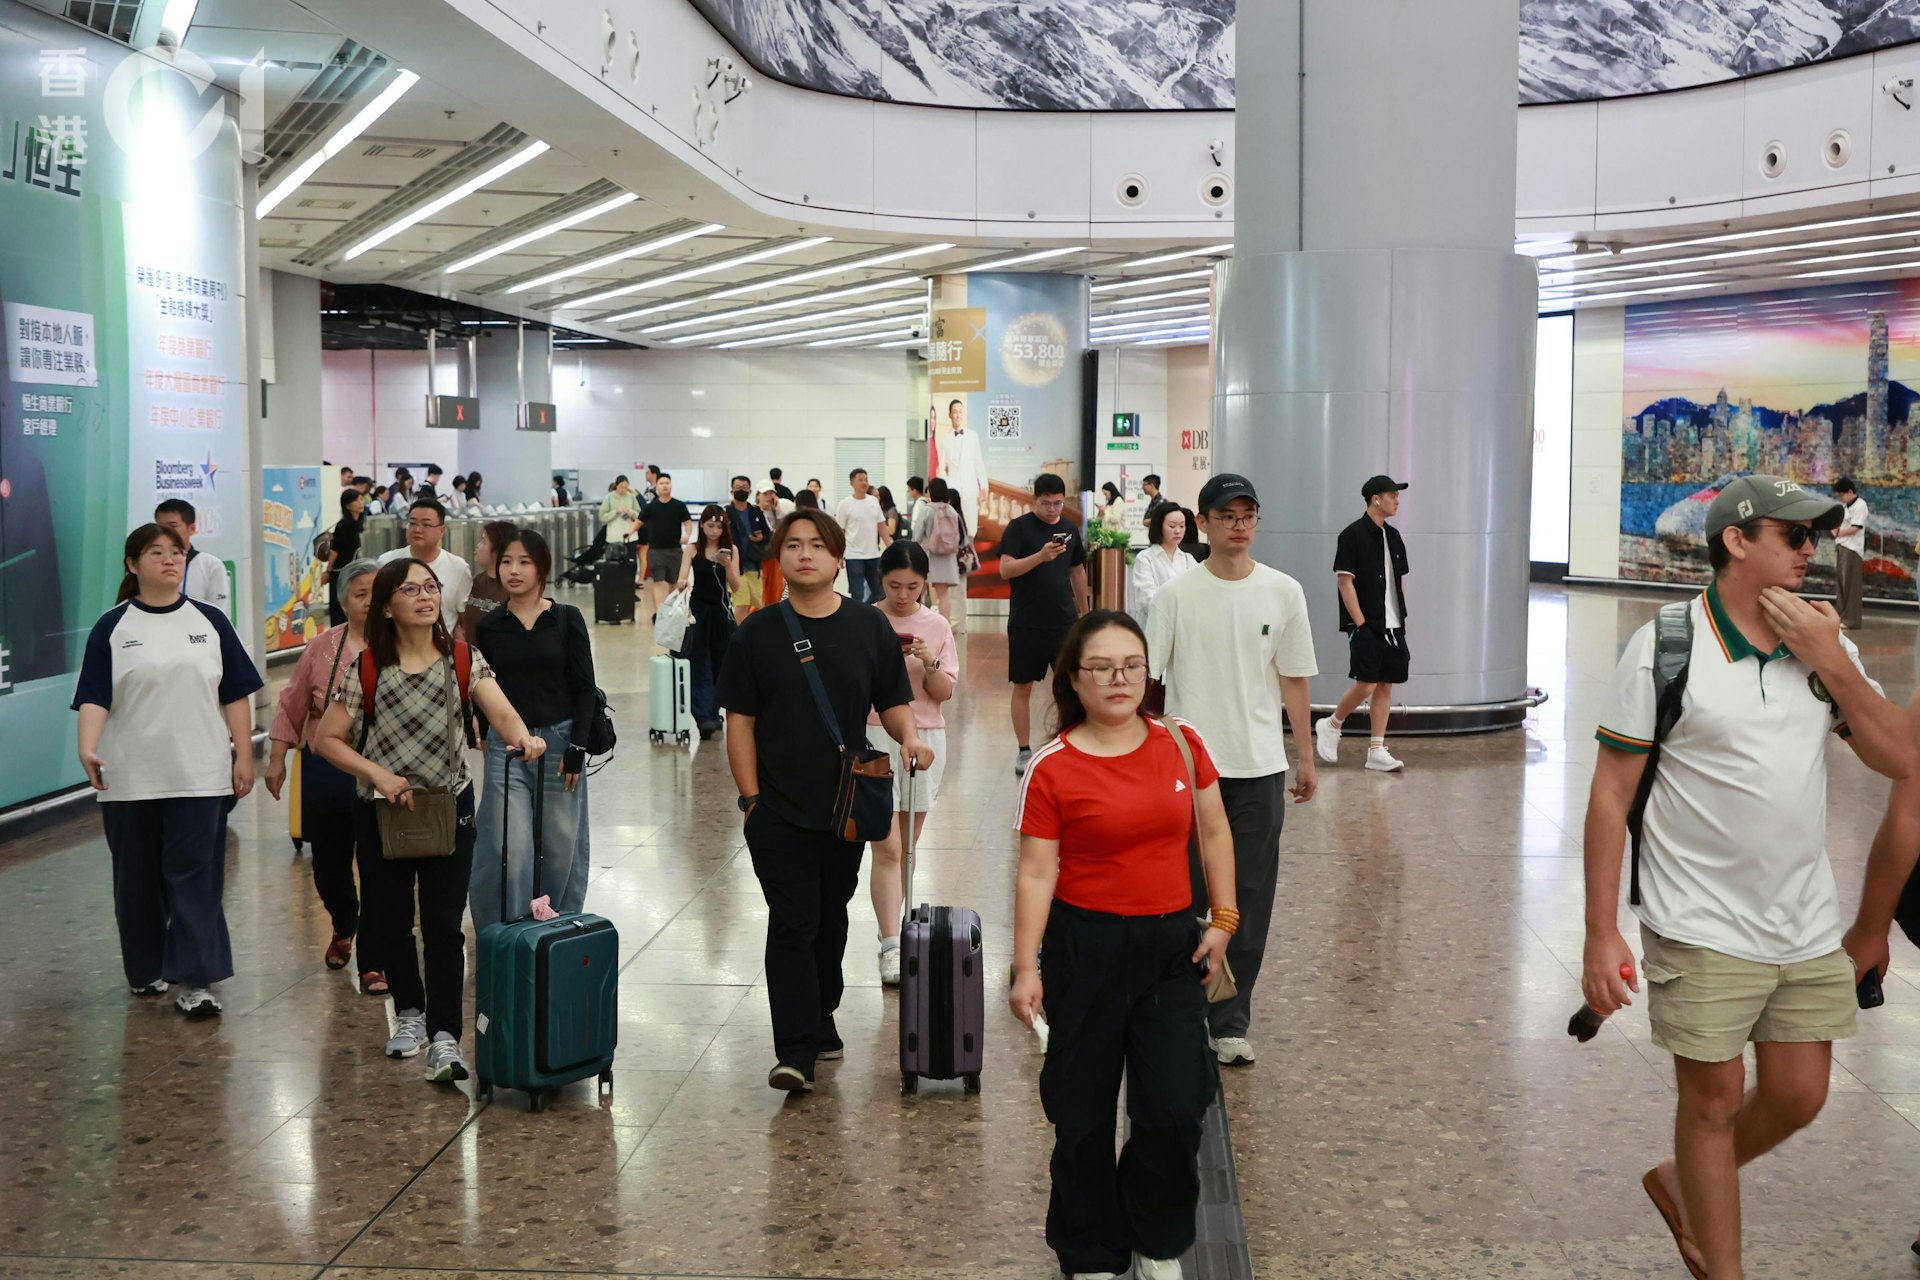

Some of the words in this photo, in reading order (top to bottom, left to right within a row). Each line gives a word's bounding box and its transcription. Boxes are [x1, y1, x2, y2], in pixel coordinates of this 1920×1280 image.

[2, 119, 83, 198] 恒生
[156, 460, 193, 477] Bloomberg
[1192, 456, 1210, 471] 星展
[156, 475, 204, 489] Businessweek
[1738, 500, 1754, 519] FJ
